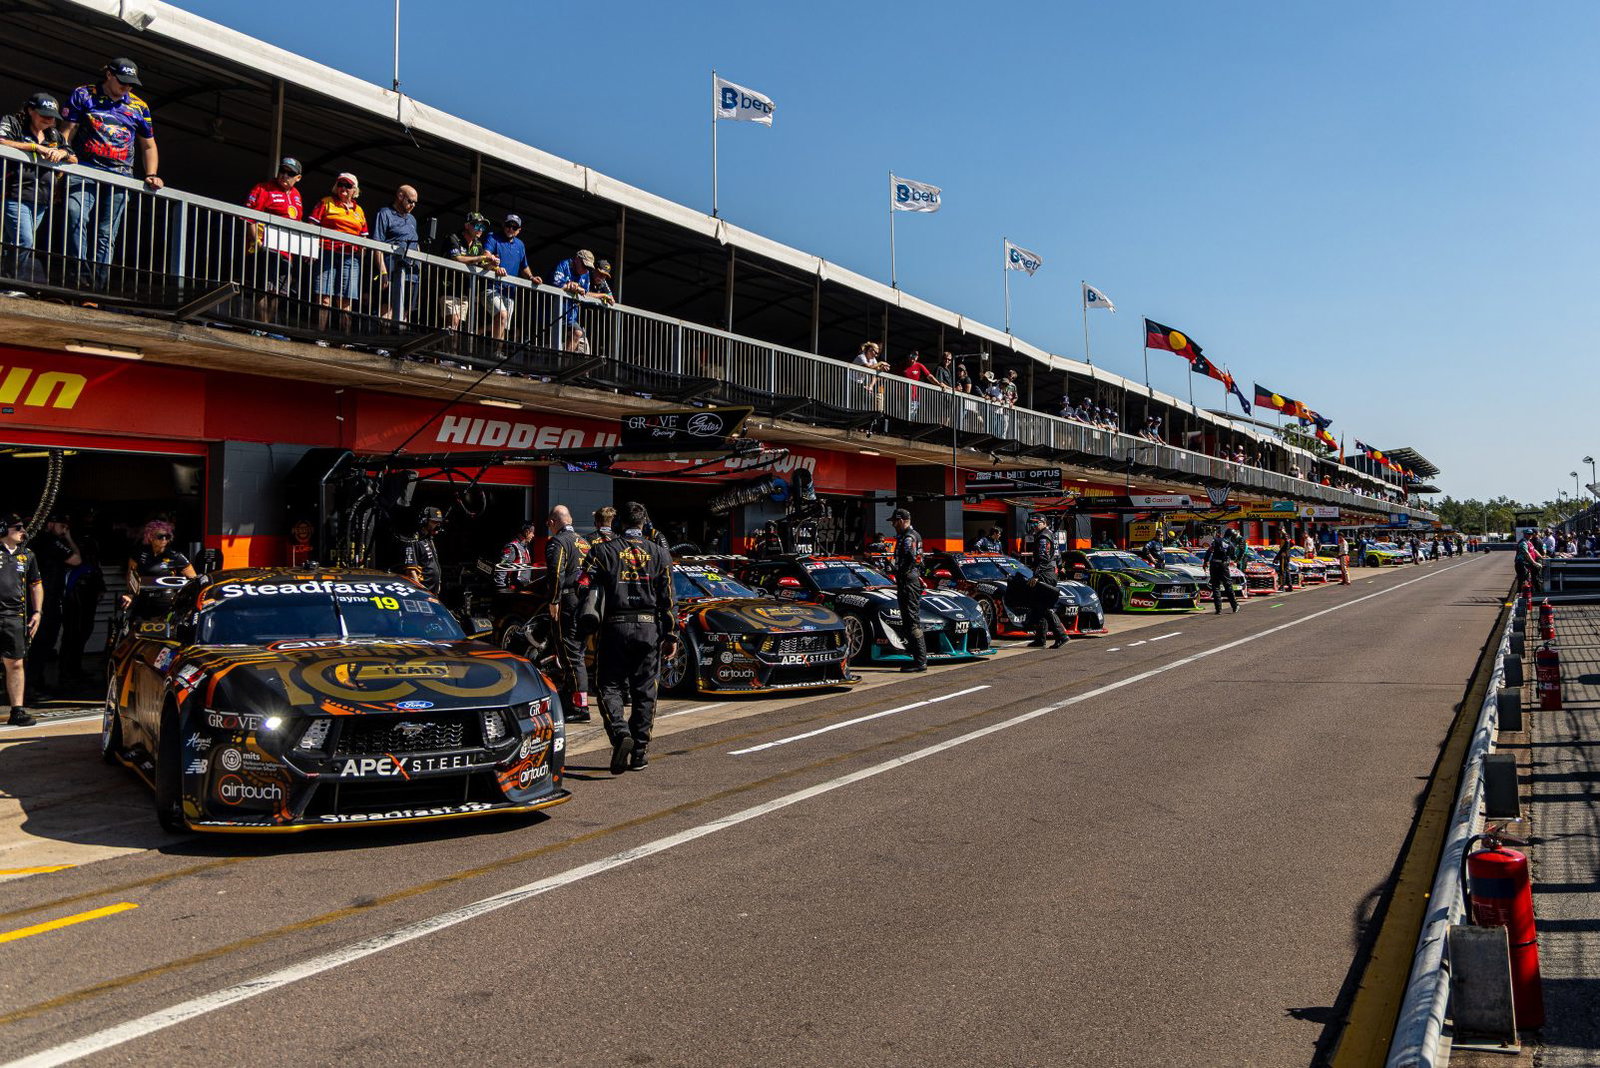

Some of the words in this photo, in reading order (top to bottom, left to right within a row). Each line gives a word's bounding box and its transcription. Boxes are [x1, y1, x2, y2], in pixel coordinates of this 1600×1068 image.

[741, 92, 773, 114] bet
[628, 415, 679, 429] GROVE
[688, 415, 720, 435] Gates
[436, 415, 585, 450] HIDDEN
[651, 428, 677, 438] Racing
[1029, 469, 1061, 478] OPTUS
[221, 580, 385, 598] Steadfast
[370, 596, 400, 610] 19
[781, 653, 811, 667] APEX
[810, 654, 833, 663] STEEL
[718, 667, 755, 678] airtouch
[208, 714, 259, 731] GROVE
[340, 753, 411, 781] APEX
[412, 755, 474, 772] STEEL
[520, 761, 549, 783] airtouch
[221, 782, 281, 800] airtouch
